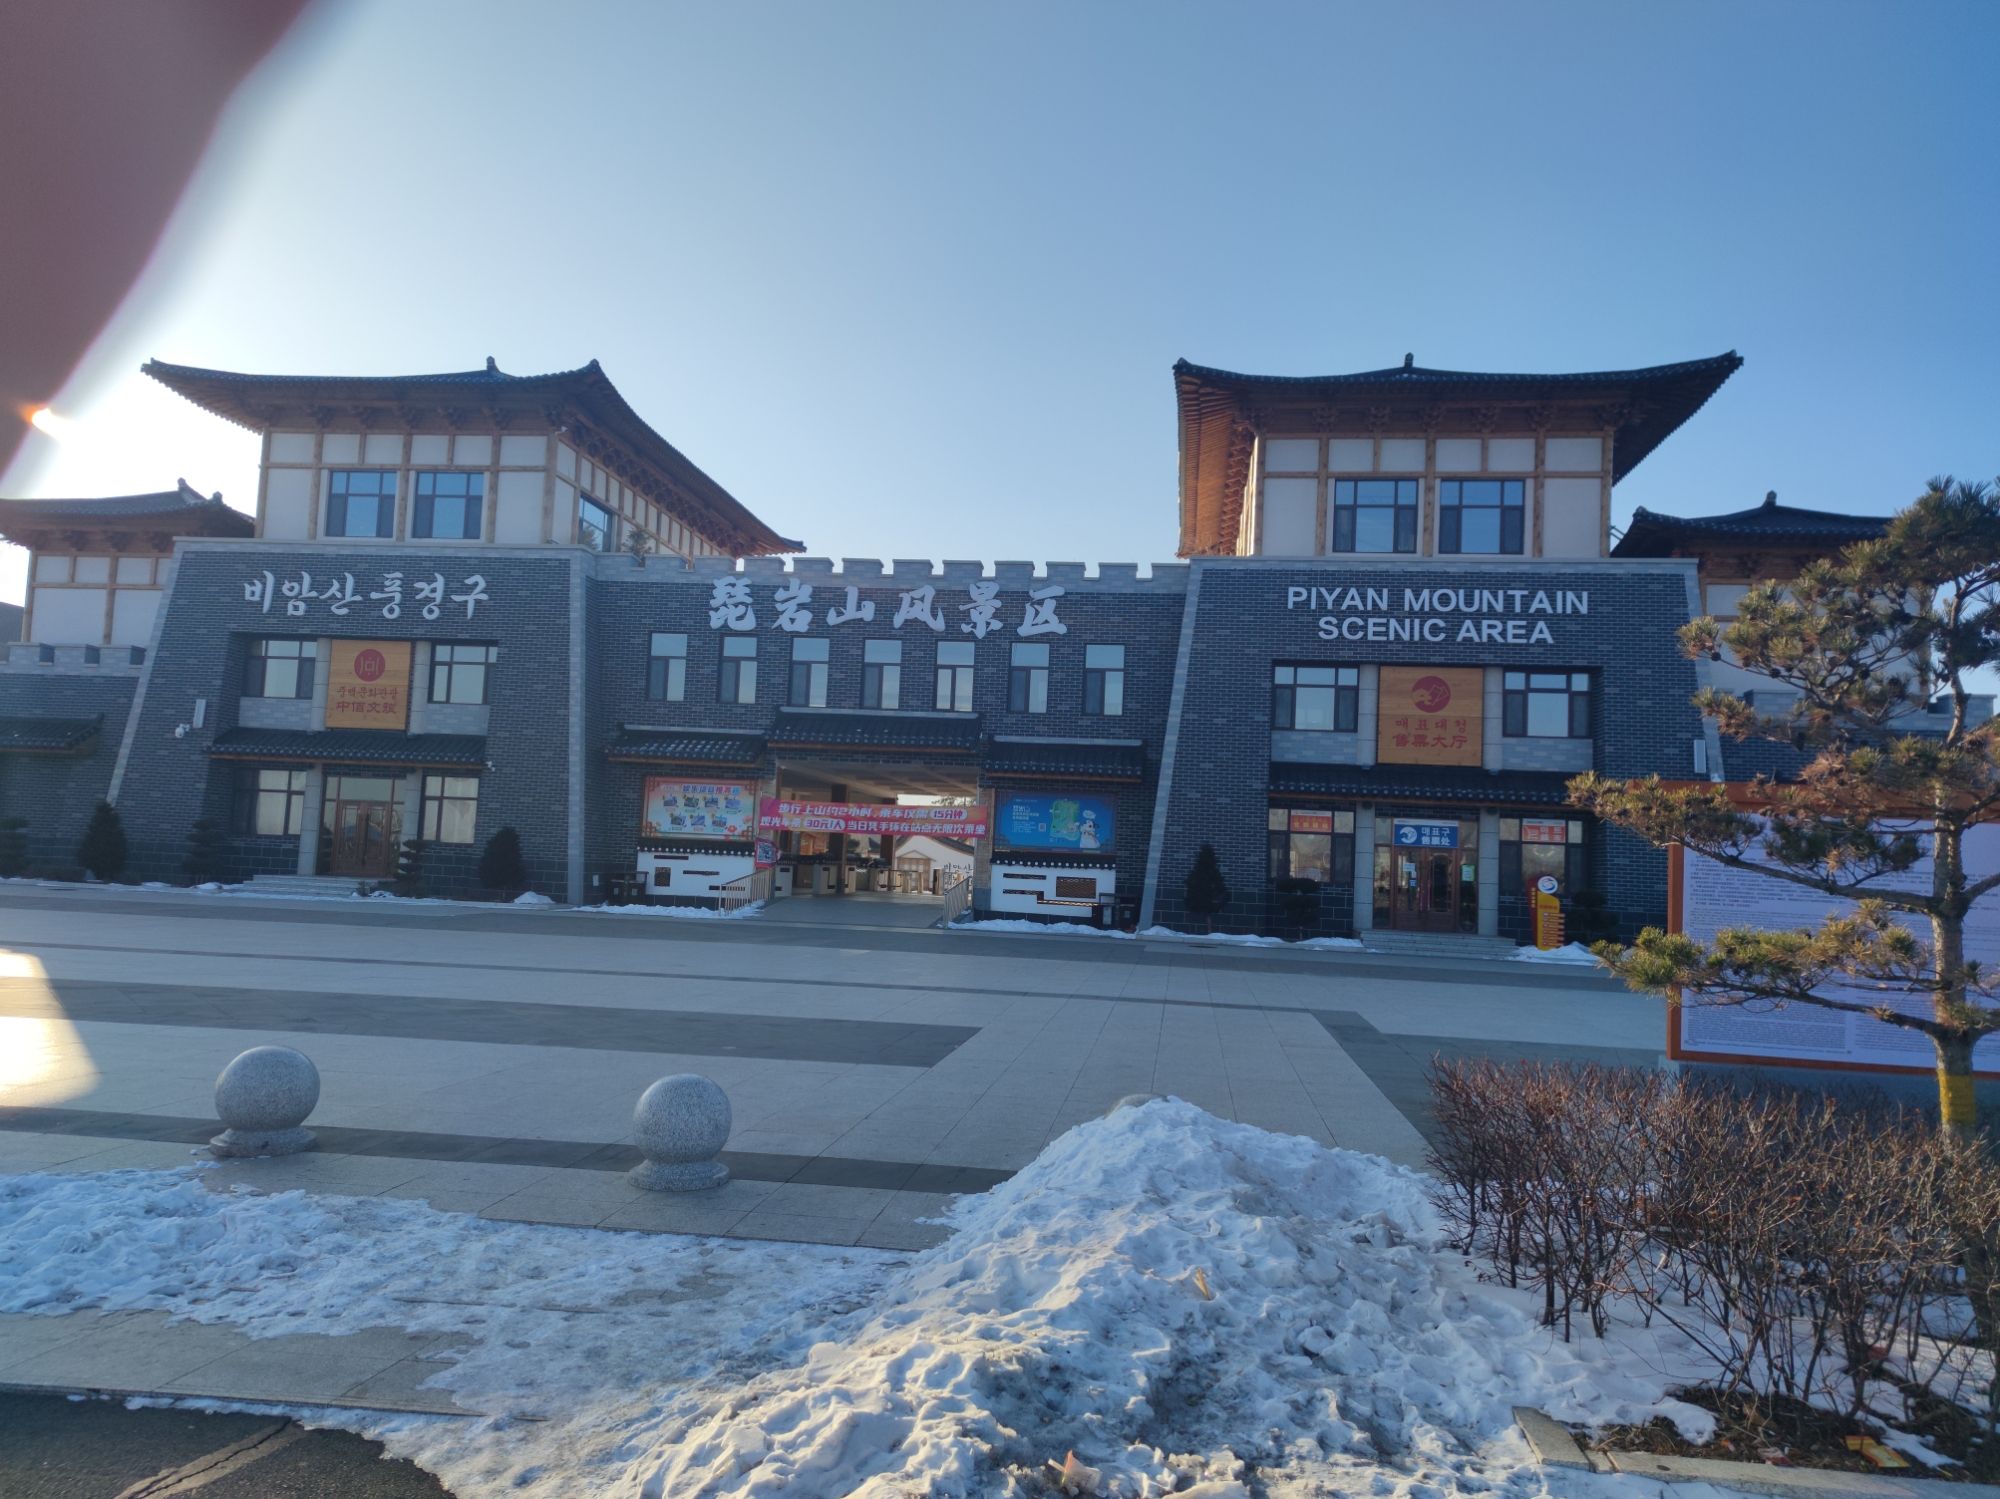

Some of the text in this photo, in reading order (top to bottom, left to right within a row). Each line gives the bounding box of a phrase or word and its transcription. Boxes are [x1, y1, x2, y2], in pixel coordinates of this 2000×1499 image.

[243, 570, 489, 620] 비암산풍경구
[1287, 586, 1588, 614] PIYAN MOUNTAIN
[709, 576, 1068, 639] 琵岩山风景区
[1318, 616, 1554, 644] SCENIC AREA
[1392, 733, 1468, 749] 售票大厅
[934, 809, 963, 819] 15分钟
[1421, 827, 1450, 836] 매표구
[1421, 836, 1451, 846] 售票处
